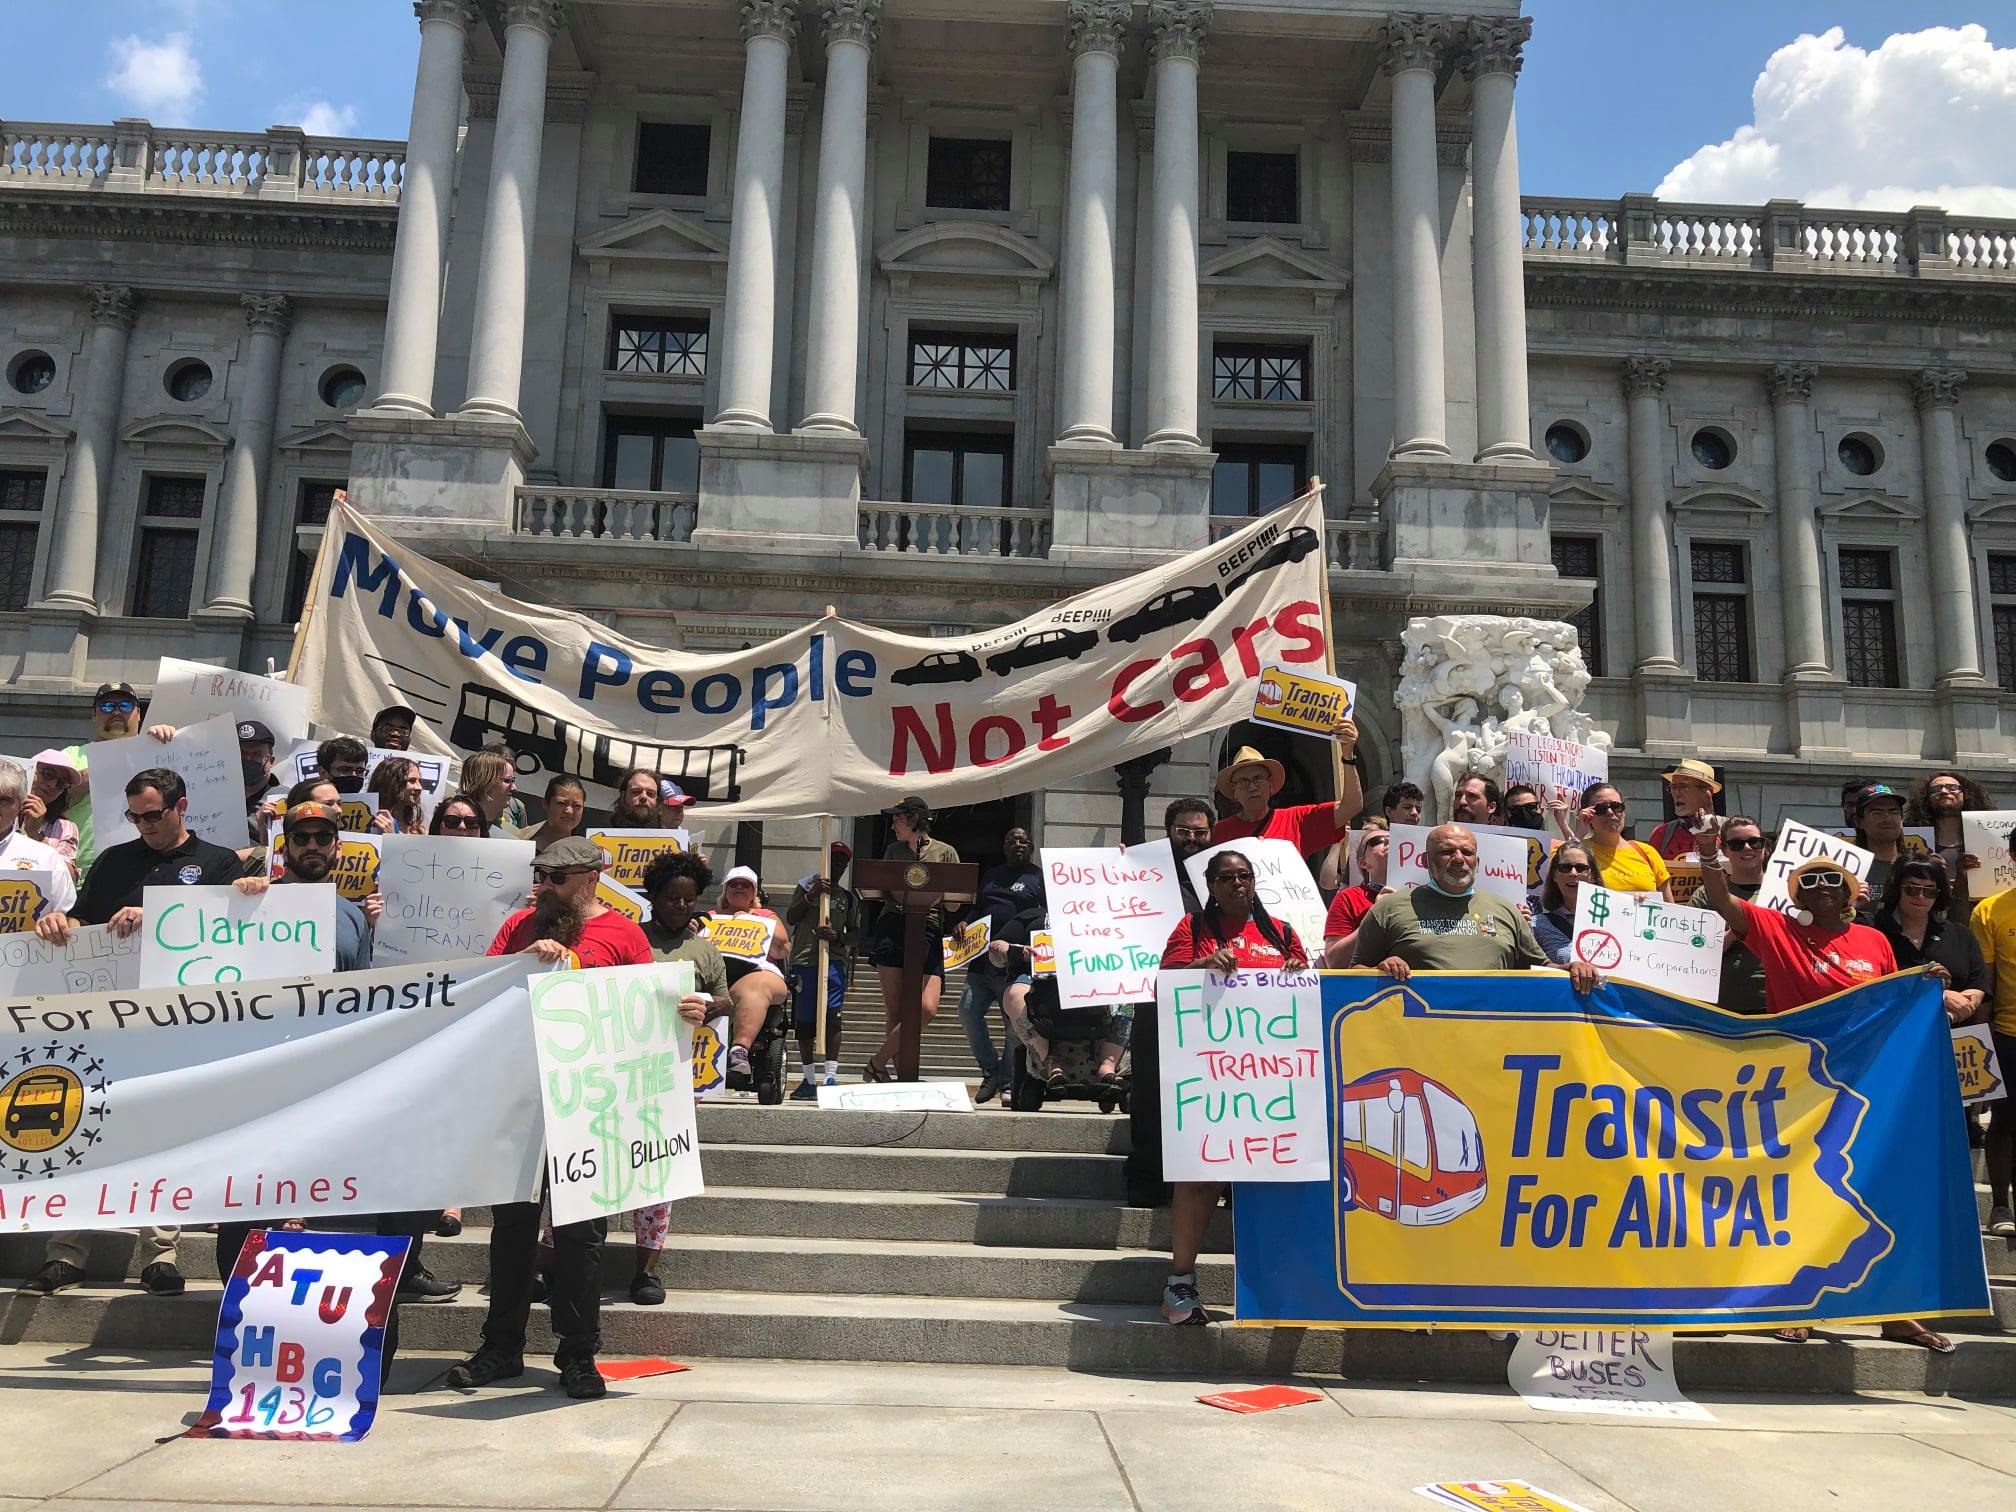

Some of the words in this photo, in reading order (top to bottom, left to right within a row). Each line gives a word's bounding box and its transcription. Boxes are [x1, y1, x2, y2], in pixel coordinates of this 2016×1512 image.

[331, 532, 549, 684] Move
[578, 634, 877, 730] People
[178, 667, 278, 702] TRANSIT
[889, 693, 1072, 775] Not
[1108, 600, 1325, 723] cars
[1286, 681, 1342, 711] Transit
[1280, 702, 1300, 718] For
[1299, 706, 1317, 722] All
[1317, 710, 1337, 726] PA!
[1509, 732, 1531, 748] HEY
[1528, 750, 1558, 764] LISTEN
[1506, 760, 1542, 783] DON'T
[344, 874, 365, 891] PA!
[402, 849, 504, 889] State
[614, 865, 630, 879] For
[1051, 862, 1096, 886] BUS
[1484, 859, 1524, 885] with
[1062, 899, 1097, 915] are
[1107, 895, 1152, 915] Life
[1282, 880, 1316, 902] the
[385, 891, 477, 930] College
[1416, 919, 1445, 929] TRANSIT
[1446, 919, 1477, 929] TOWARD
[1621, 908, 1634, 918] for
[155, 902, 323, 952] Clarion
[713, 922, 762, 941] Transit
[1070, 921, 1125, 940] Lines
[1419, 927, 1478, 936] TRANSFORMATION
[725, 938, 739, 949] All
[740, 940, 756, 951] PA!
[1068, 949, 1124, 976] FUND
[1628, 950, 1641, 962] for
[1647, 952, 1719, 977] Corporations
[1209, 972, 1250, 989] 1.65
[1256, 972, 1320, 988] BILLION
[7, 1003, 95, 1034] For
[107, 988, 276, 1029] Public
[282, 971, 457, 1018] Transit
[1174, 985, 1299, 1048] Fund
[1197, 1048, 1320, 1082] TRANSIT
[547, 1062, 618, 1119] US
[614, 1050, 676, 1104] THE
[1175, 1077, 1297, 1132] Fund
[1502, 1053, 1792, 1161] Transit
[553, 1149, 598, 1185] 1.65
[630, 1128, 691, 1170] BILLION
[1201, 1132, 1298, 1165] LIFE
[96, 1177, 194, 1216] Life
[224, 1174, 360, 1209] Lines
[1500, 1174, 1599, 1249] For
[1607, 1172, 1688, 1249] All
[1702, 1173, 1792, 1248] PA!
[1546, 1355, 1647, 1388] BUSES
[228, 1381, 335, 1428] 1436
